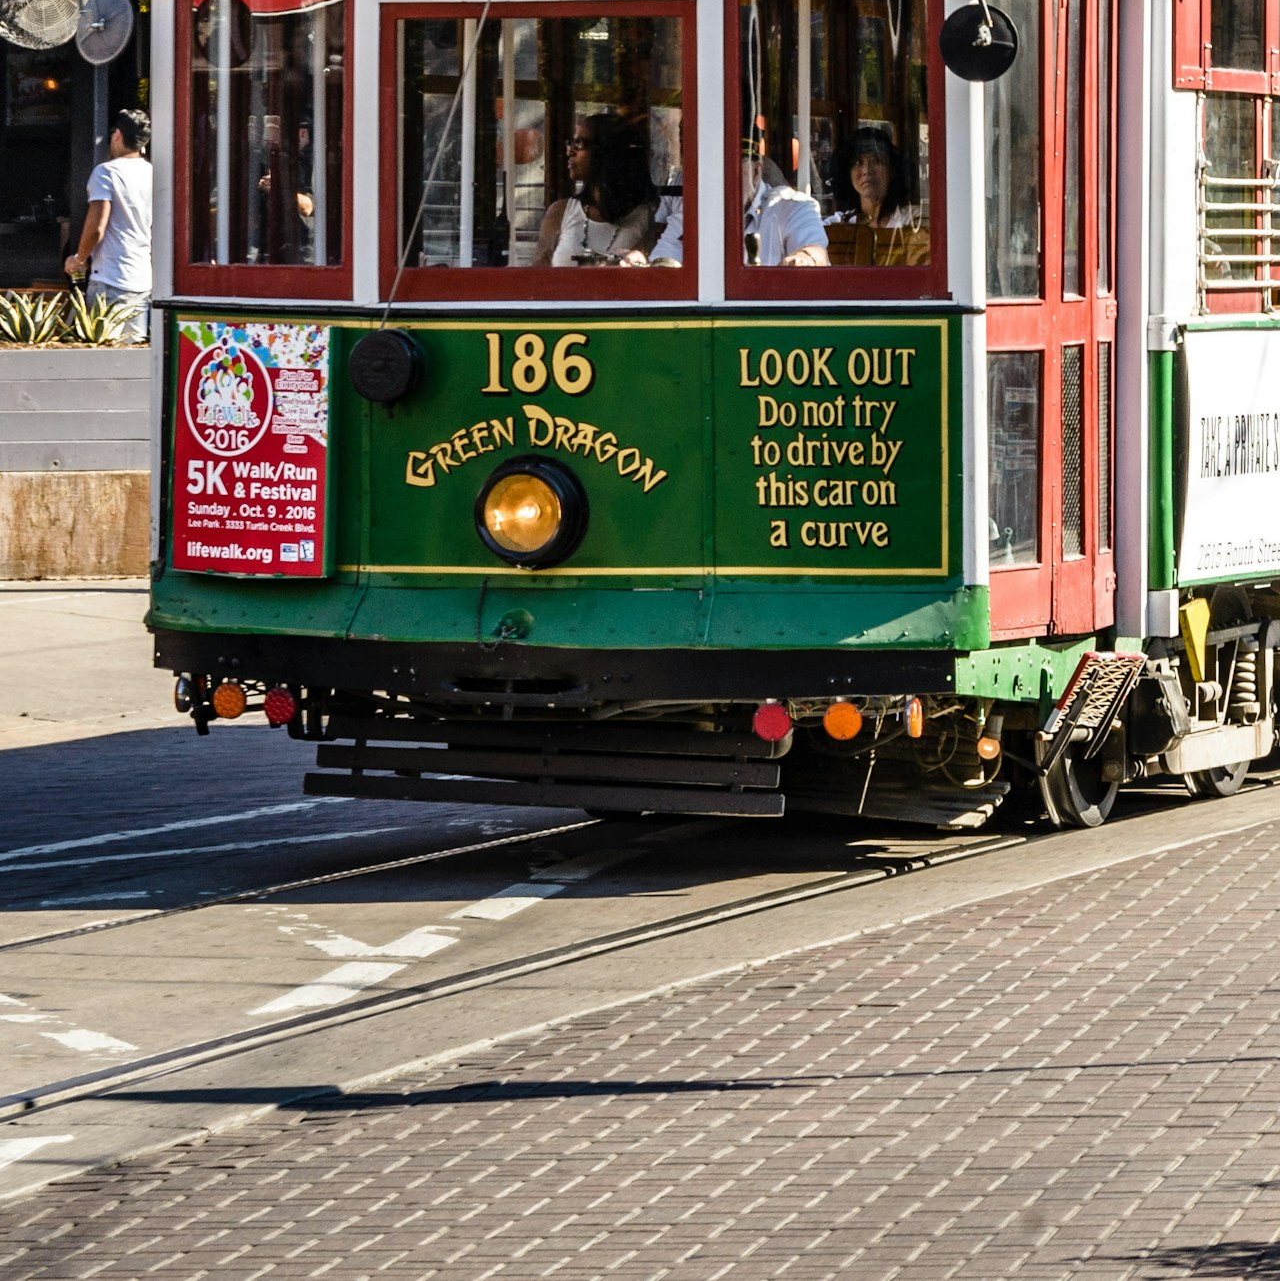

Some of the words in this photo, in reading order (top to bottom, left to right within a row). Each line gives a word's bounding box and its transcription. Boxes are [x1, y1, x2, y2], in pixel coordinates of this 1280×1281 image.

[480, 332, 593, 394] 186
[738, 347, 839, 387] LOOK
[847, 347, 917, 386] OUT
[757, 395, 797, 427] Do
[802, 394, 846, 427] not
[852, 394, 897, 435] try
[204, 429, 250, 449] 2016
[750, 434, 781, 466] to
[786, 431, 865, 466] drive
[870, 431, 904, 476] by
[1200, 416, 1223, 478] TAKE
[1224, 416, 1231, 477] A
[1234, 413, 1270, 476] PRIVATE
[186, 460, 228, 496] 5K
[232, 461, 318, 482] Walk/Run
[233, 482, 246, 499] &
[250, 482, 317, 501] Festival
[755, 471, 810, 506] this
[813, 479, 859, 507] car
[862, 479, 897, 506] on
[187, 501, 231, 517] Sunday
[239, 504, 265, 519] Oct.
[267, 505, 277, 518] 9
[285, 506, 317, 521] 2016
[187, 518, 202, 528] Lee
[202, 519, 221, 529] Park
[245, 521, 270, 531] Turtle
[270, 522, 294, 533] Creek
[770, 519, 788, 547] a
[800, 520, 889, 547] curve
[187, 541, 273, 563] lifewalk.org
